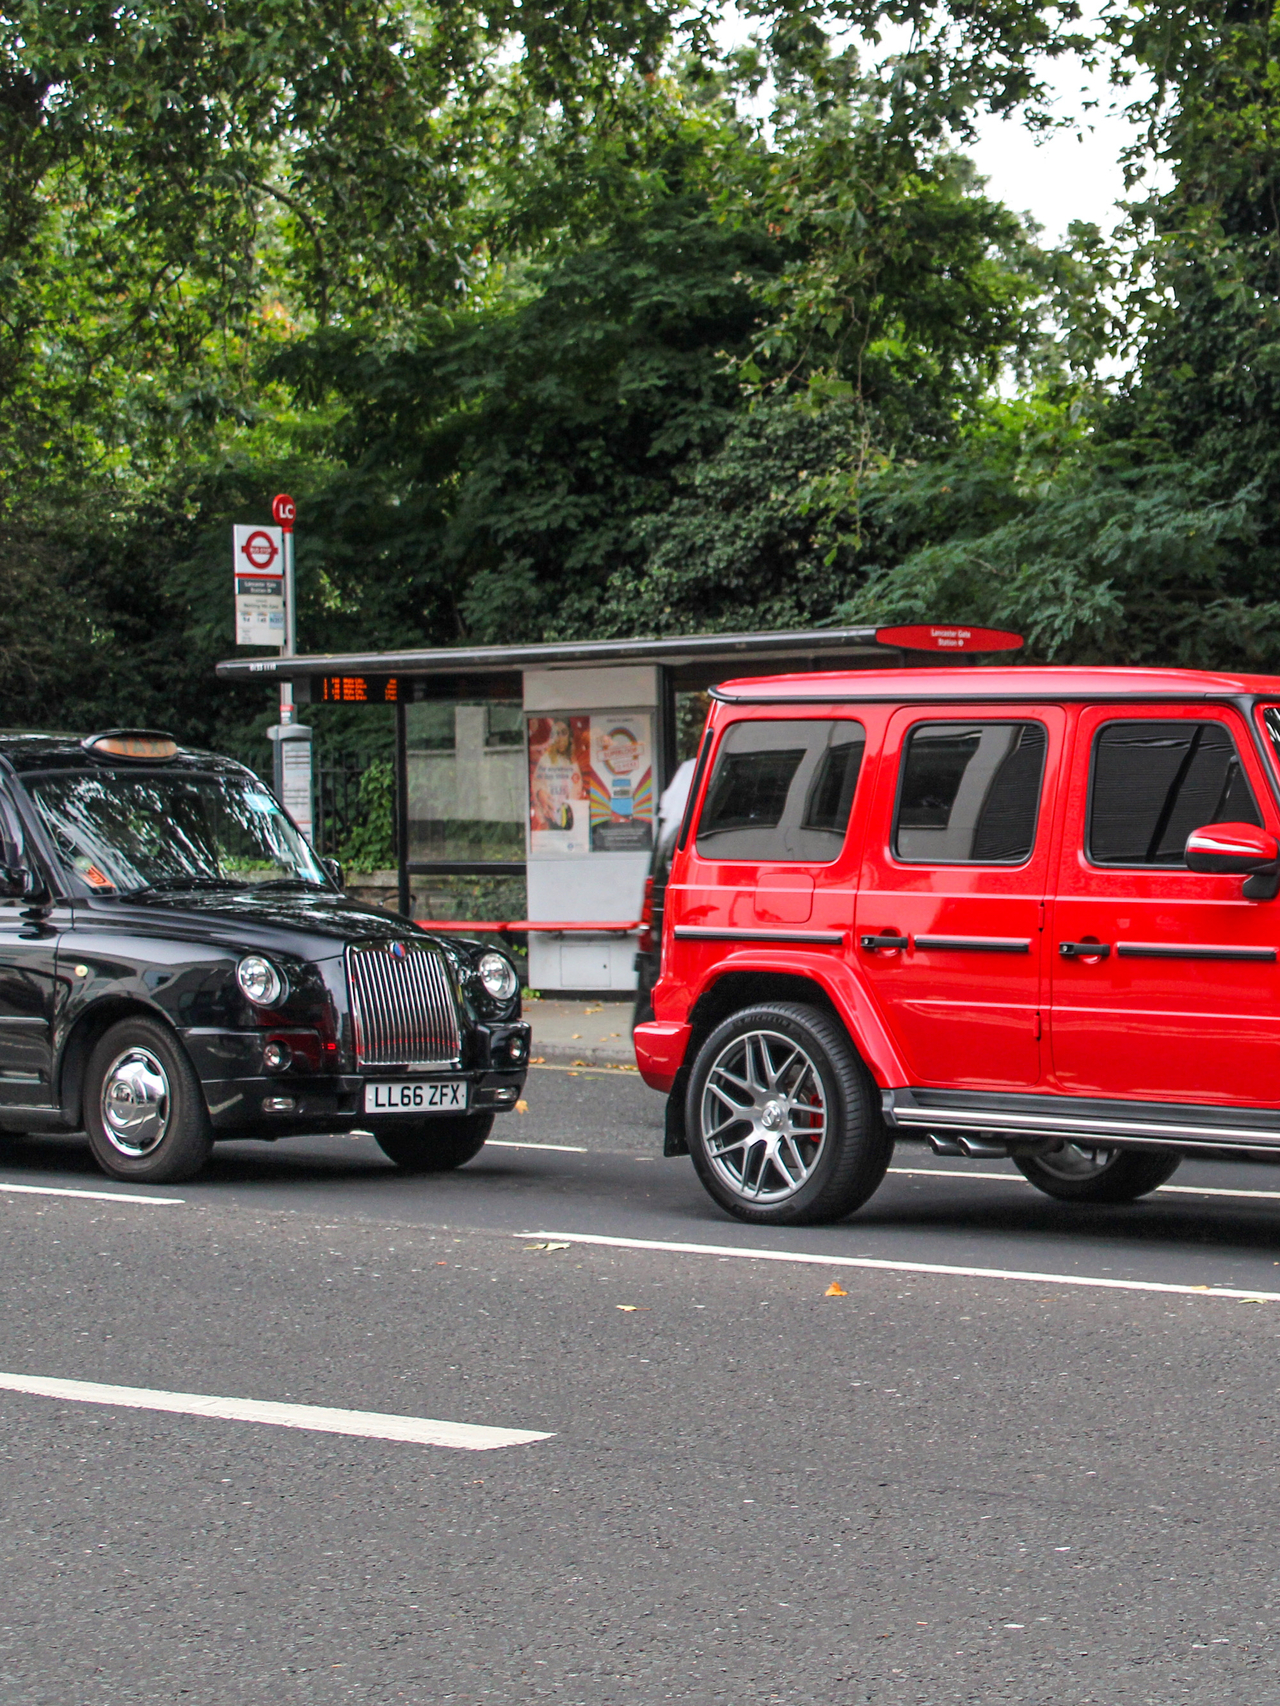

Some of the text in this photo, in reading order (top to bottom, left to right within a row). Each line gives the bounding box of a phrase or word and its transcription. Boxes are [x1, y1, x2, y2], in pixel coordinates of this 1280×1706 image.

[279, 503, 294, 519] LC
[931, 628, 971, 638] Lancaster Gate
[938, 638, 957, 646] Station
[117, 738, 169, 754] TAXI
[375, 1083, 460, 1108] LL66 ZFX
